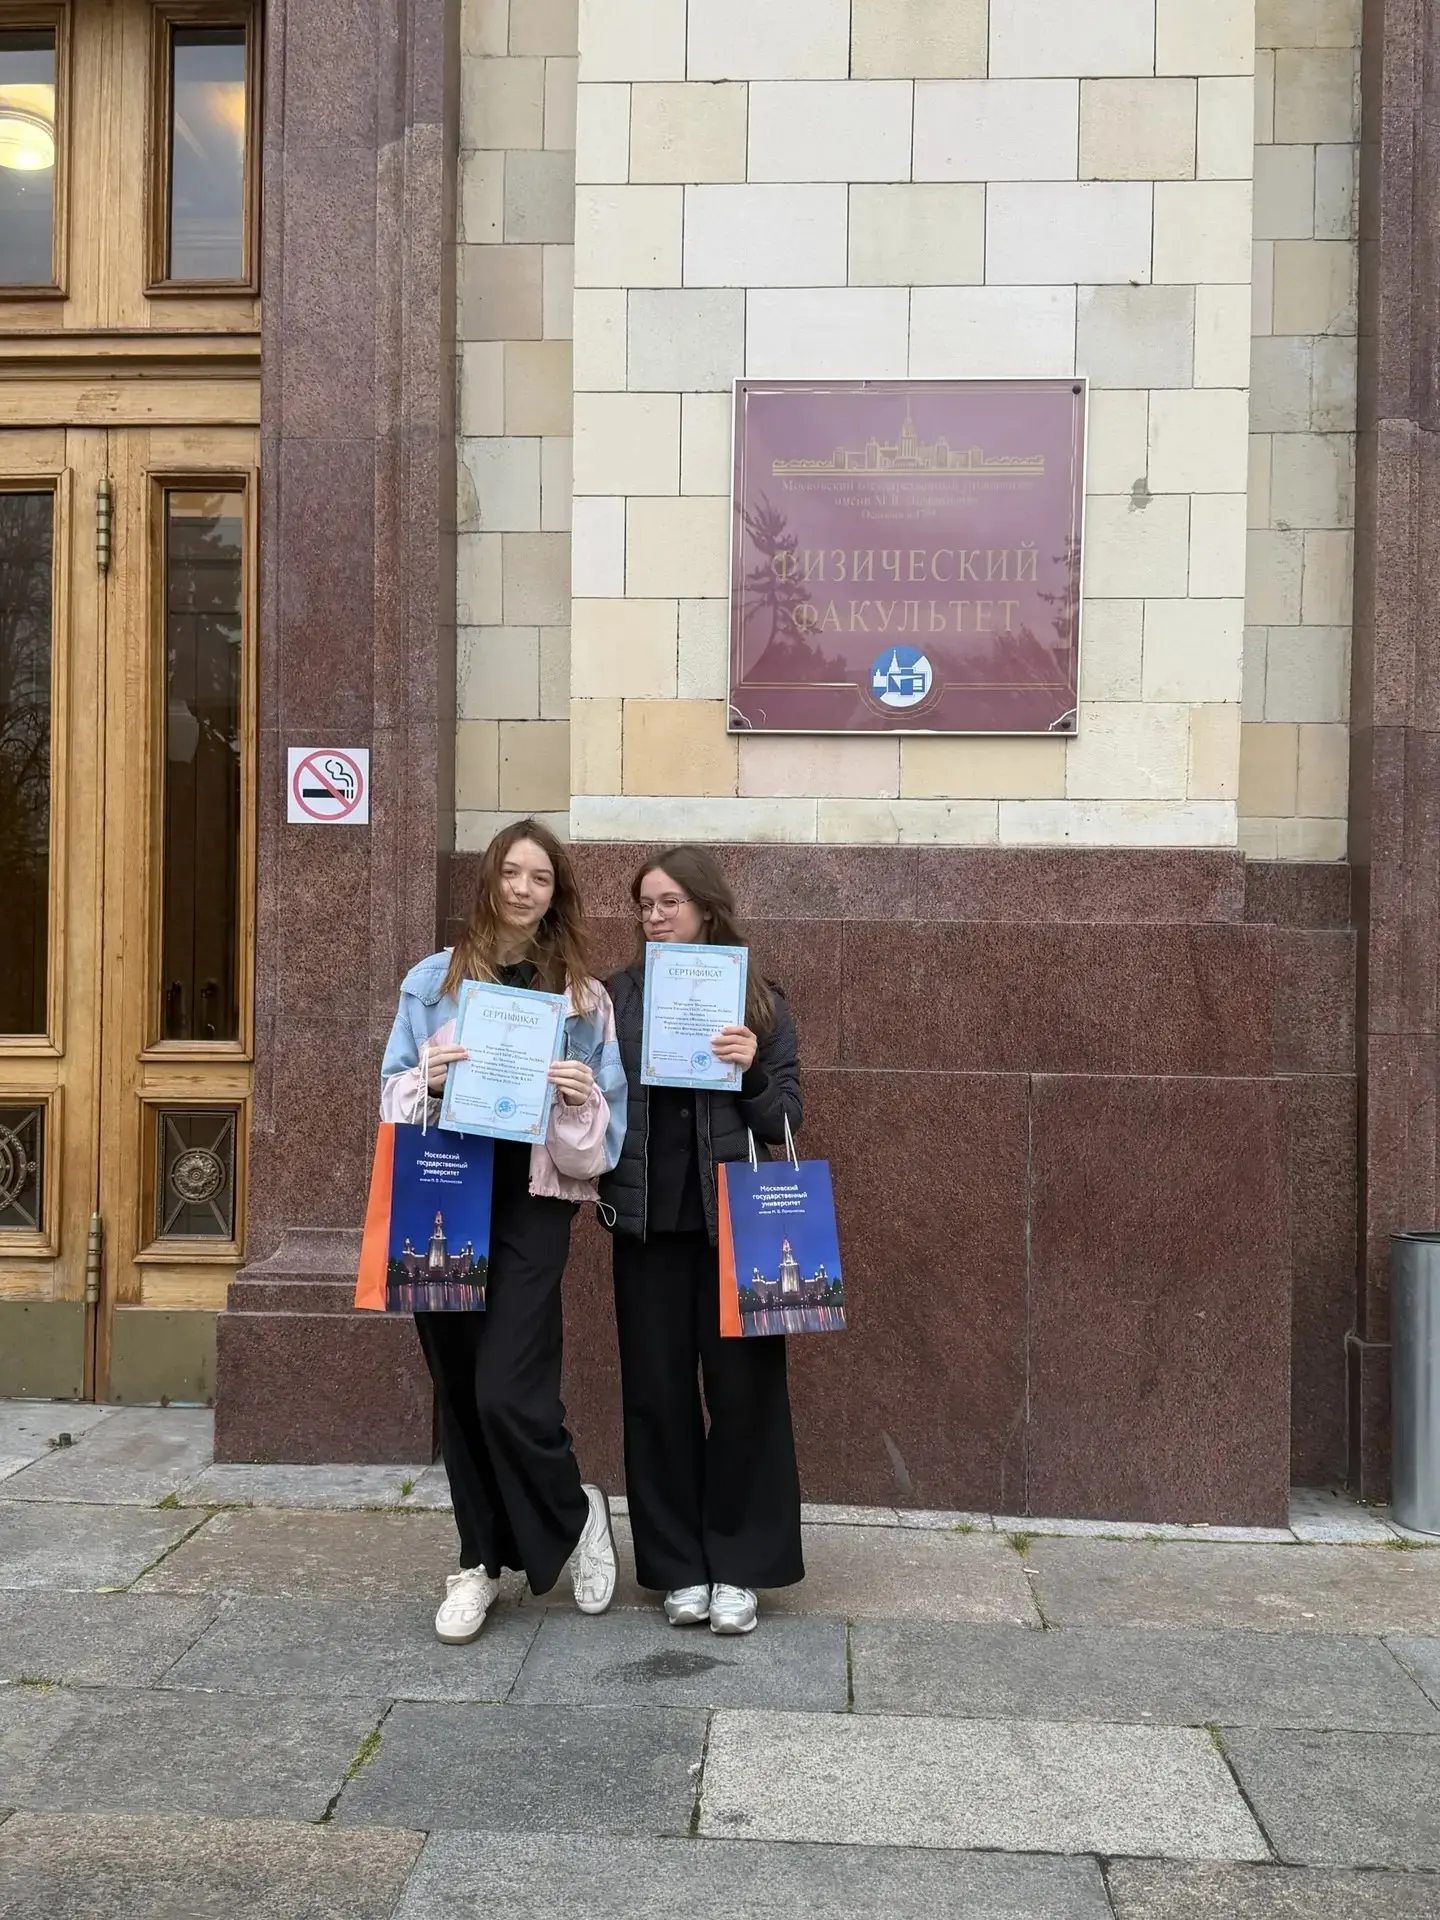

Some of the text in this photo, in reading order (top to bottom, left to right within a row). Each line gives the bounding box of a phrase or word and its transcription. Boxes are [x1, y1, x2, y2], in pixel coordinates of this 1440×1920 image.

[771, 541, 1039, 583] ФИЗИЧЕСКИЙ
[792, 600, 1019, 633] ФАКУЛЬТЕТ
[668, 967, 723, 978] СЕРТИФИКАТ
[482, 1009, 540, 1025] СЕРТИФИКАТ
[424, 1151, 460, 1160] Московский
[416, 1160, 468, 1168] государственный
[760, 1184, 799, 1192] Московский
[752, 1192, 808, 1200] государственный
[761, 1200, 801, 1208] университет
